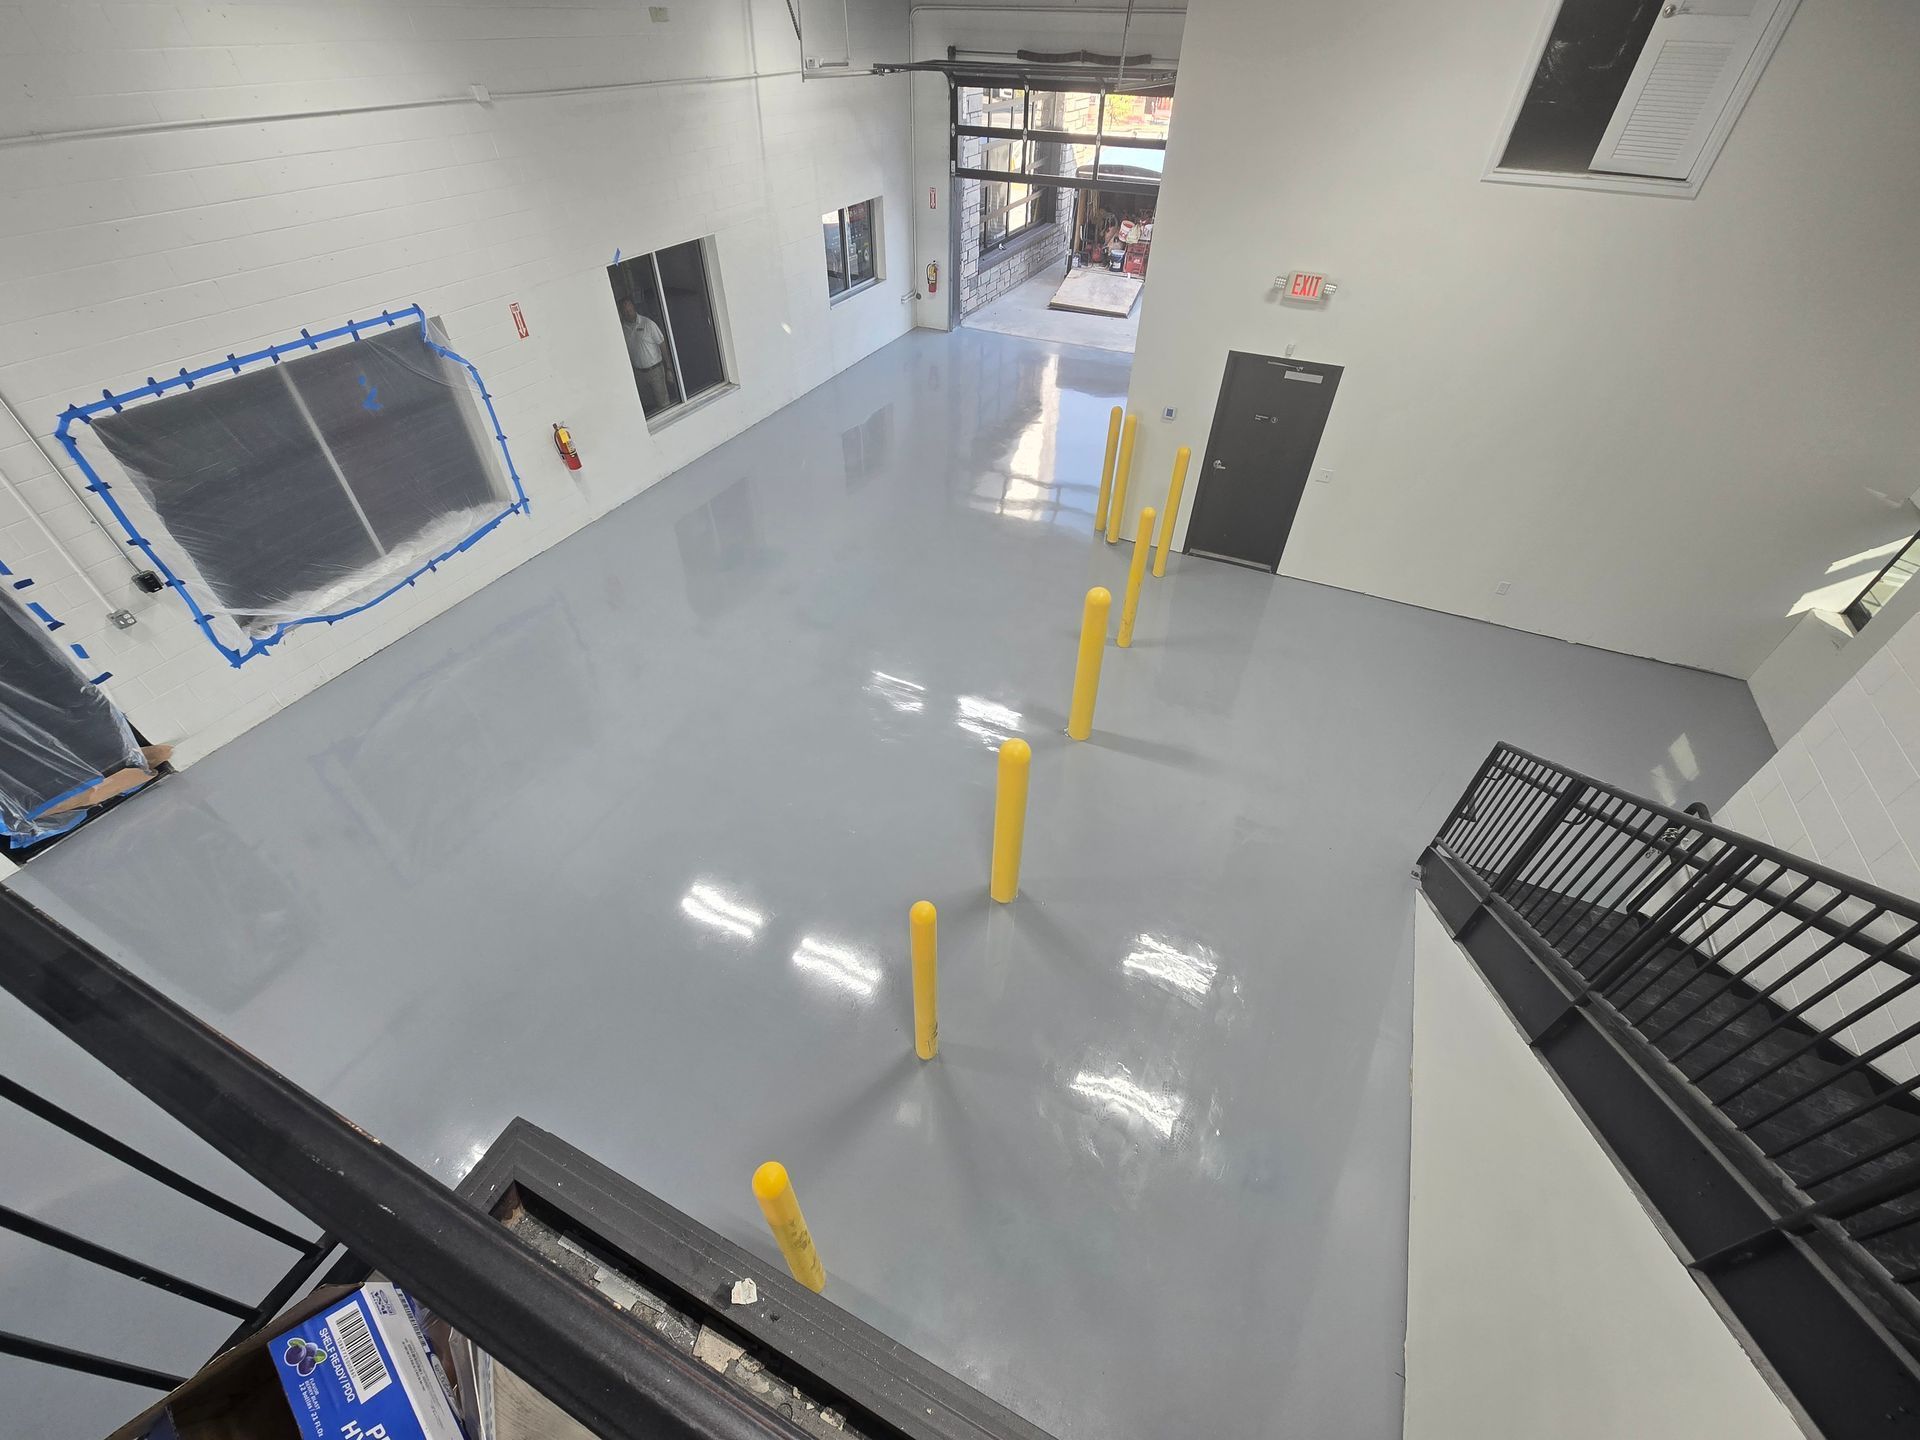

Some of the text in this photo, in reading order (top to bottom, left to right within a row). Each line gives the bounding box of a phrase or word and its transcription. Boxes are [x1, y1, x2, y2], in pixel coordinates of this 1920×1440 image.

[1291, 273, 1322, 297] EXIT
[319, 1327, 336, 1353] SHELF
[329, 1352, 347, 1380] READY
[342, 1382, 355, 1403] PDQ
[299, 1382, 306, 1392] 12
[304, 1380, 320, 1410] BERRY BLAST
[309, 1377, 320, 1396] FLAVOR
[302, 1391, 313, 1410] bottles
[311, 1411, 319, 1422] 21
